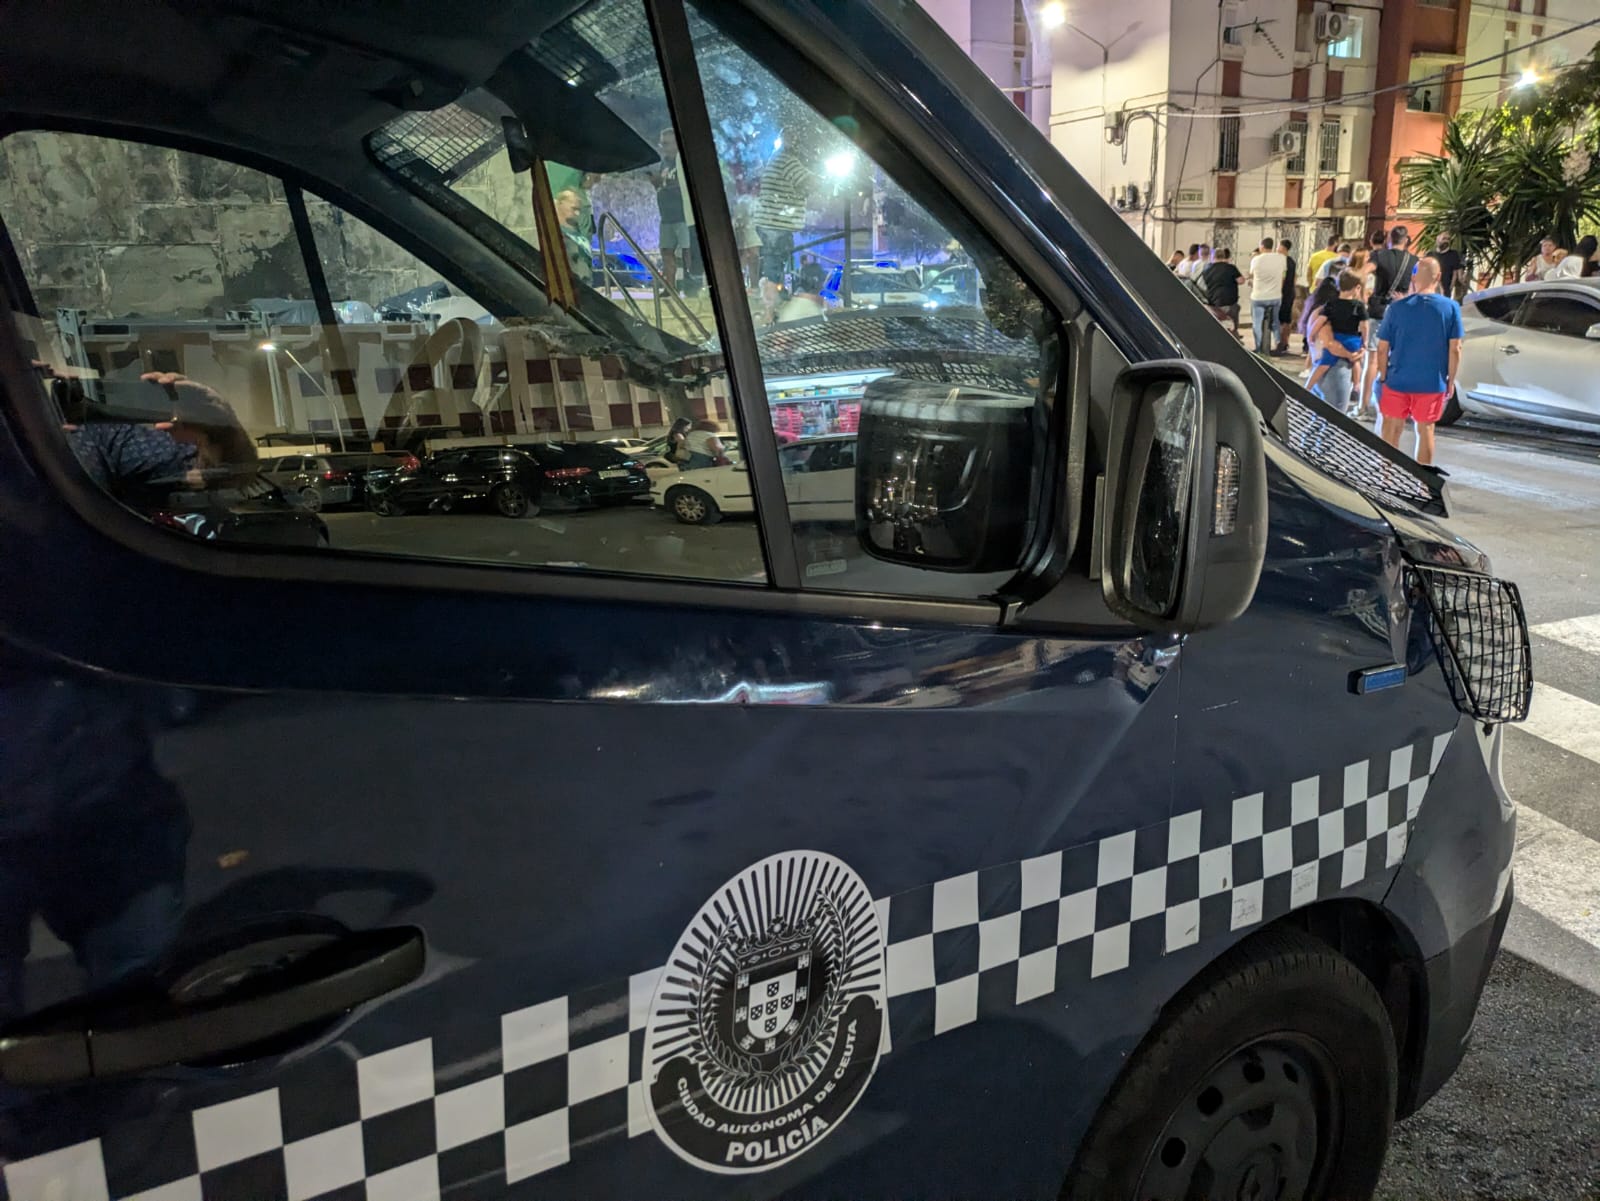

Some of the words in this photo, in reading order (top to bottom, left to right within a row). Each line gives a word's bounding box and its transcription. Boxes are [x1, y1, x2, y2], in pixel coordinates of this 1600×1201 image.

[677, 1077, 715, 1129] CIUDAD
[717, 1103, 815, 1134] AUTÓNOMA
[815, 1082, 836, 1103] DE
[834, 1019, 858, 1079] CEUTA
[725, 1115, 829, 1163] POLICÍA
